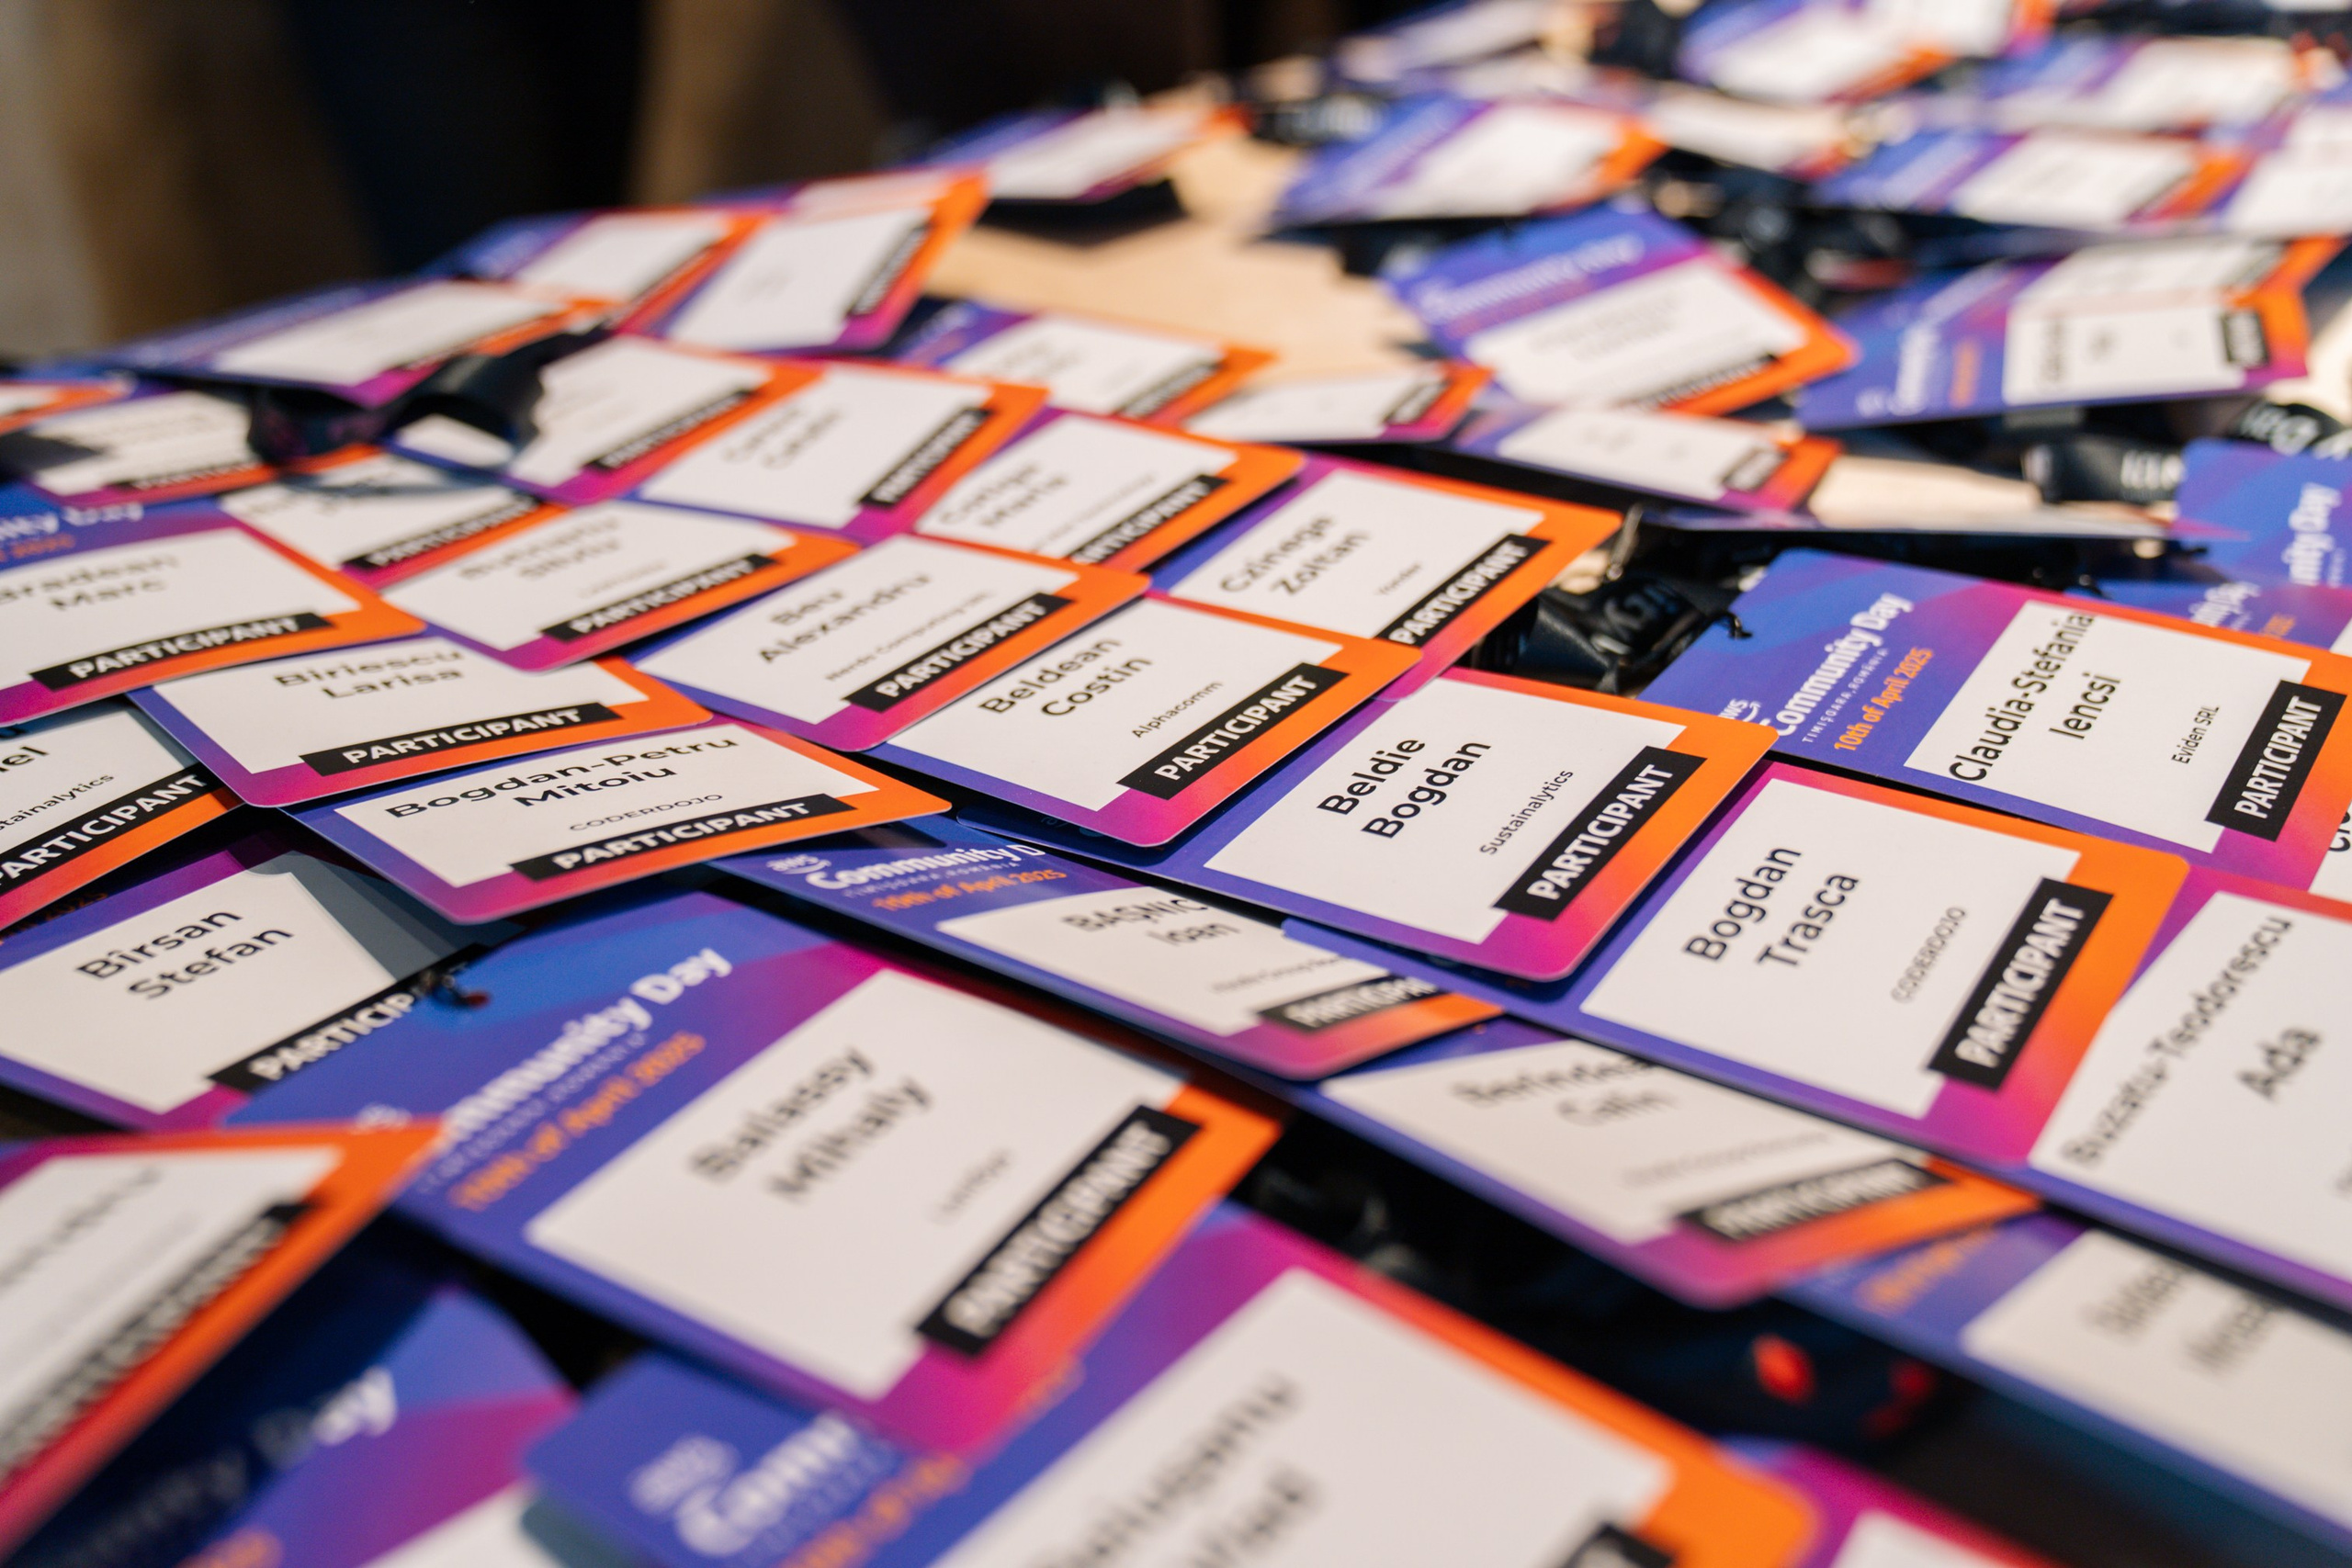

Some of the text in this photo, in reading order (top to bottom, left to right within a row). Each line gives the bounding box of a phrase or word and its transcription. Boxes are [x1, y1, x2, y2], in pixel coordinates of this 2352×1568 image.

[760, 574, 931, 663] Alexandru
[1389, 540, 1529, 645] PARTICIPANT
[68, 615, 300, 679] PARTICIPANT
[321, 669, 463, 698] Larisa
[875, 600, 1046, 698] PARTICIPANT
[979, 636, 1121, 715] Beldean
[1040, 657, 1152, 718] Costin
[1759, 592, 1914, 737] Community Day
[342, 708, 582, 763] PARTICIPANT
[1132, 681, 1224, 739] Alphacomm
[1154, 674, 1317, 781] PARTICIPANT
[1835, 647, 1933, 750] 10th of April 2025
[2172, 705, 2220, 764] Eviden SRL
[384, 737, 740, 818] Bogdan-Petru
[513, 765, 677, 807] Mitoiu
[1317, 739, 1426, 816] Beldie
[1361, 741, 1492, 839] Bogdan
[2233, 695, 2322, 818] PARTICIPANT
[0, 773, 208, 886] ARTICIPANT
[551, 802, 810, 870] PARTICIPANT
[569, 794, 723, 831] CODERDOJO
[1479, 769, 1574, 855] Sustainalytics
[1526, 764, 1673, 900] PARTICIPANT
[806, 844, 1022, 889] Community
[1683, 846, 1803, 961] Bogdan
[1756, 874, 1860, 967] Trasca
[128, 929, 294, 999] Stefan
[1954, 898, 2085, 1069] PARTICIPANT
[2236, 1026, 2323, 1103] Ada
